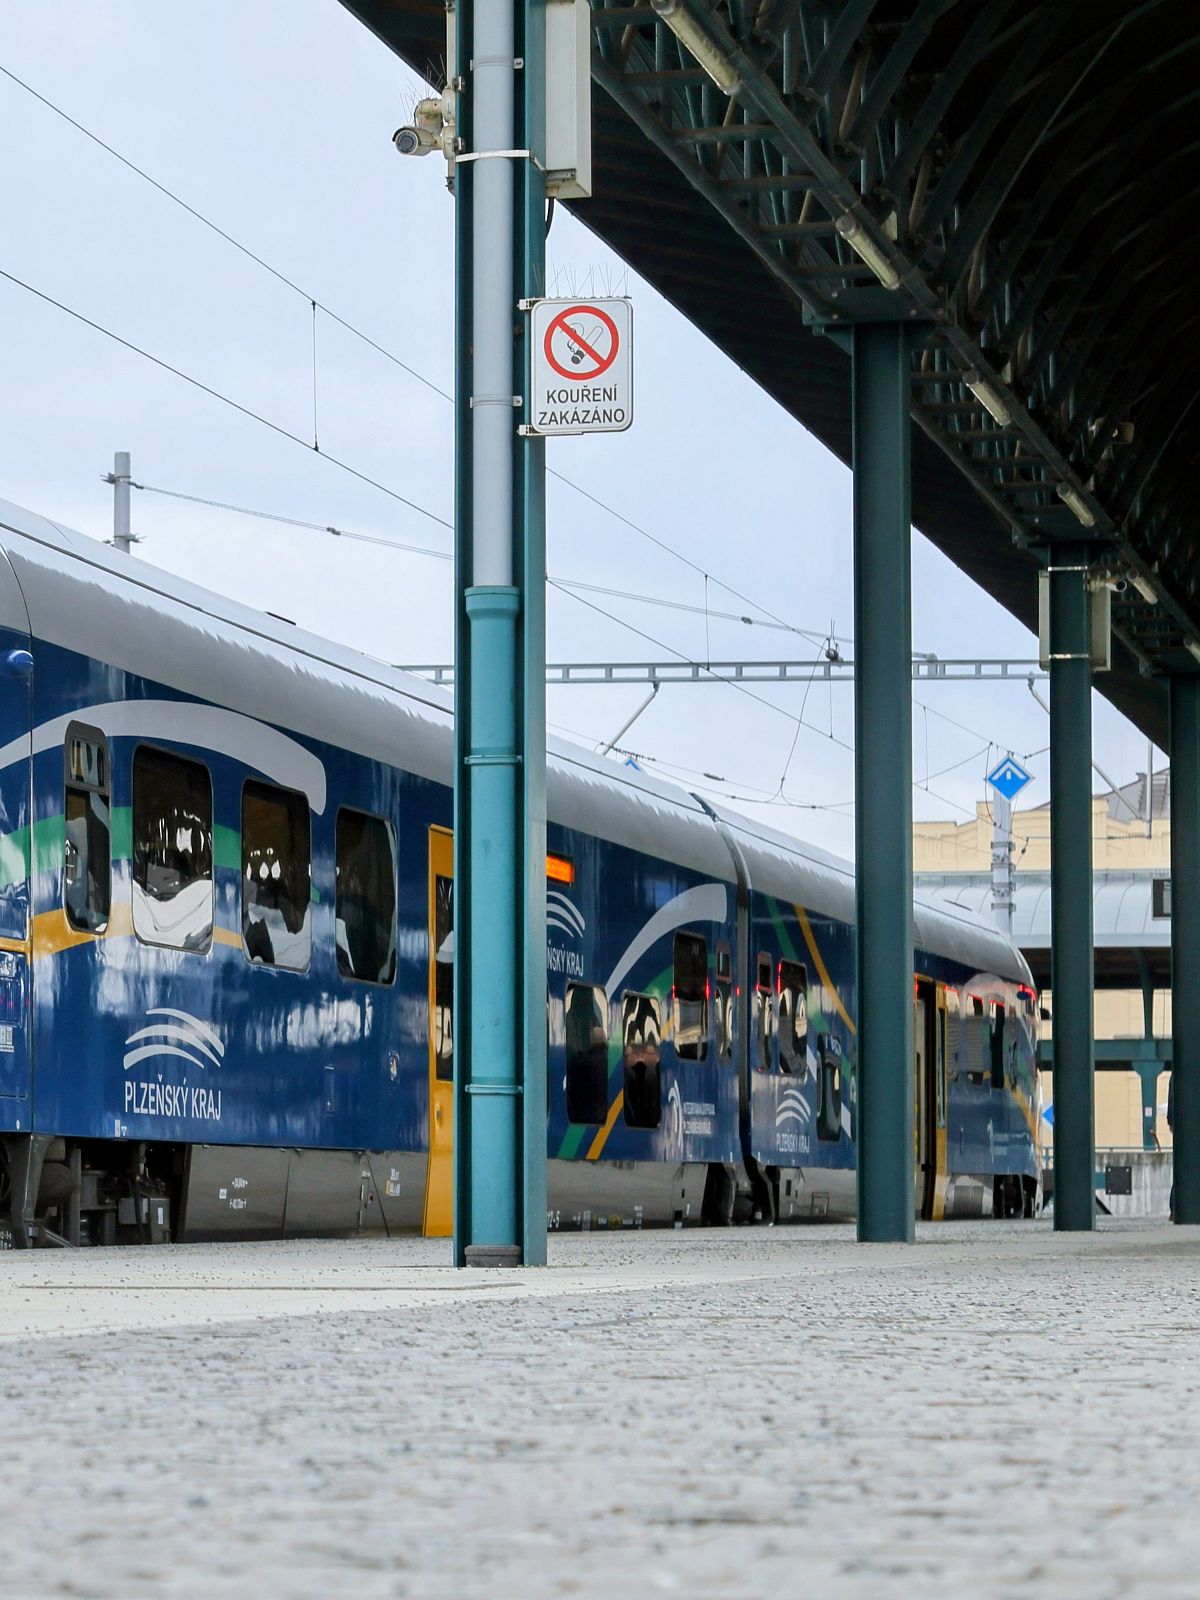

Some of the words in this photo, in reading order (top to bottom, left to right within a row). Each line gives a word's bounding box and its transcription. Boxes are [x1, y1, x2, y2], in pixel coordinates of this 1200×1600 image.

[546, 384, 618, 405] KOUŘENÍ
[538, 406, 625, 426] ZAKÁZÁNO
[547, 939, 566, 973] ŇSKÝ
[567, 951, 584, 977] KRAJ
[125, 1073, 189, 1118] PLZEŇSKÝ
[191, 1087, 221, 1121] KRAJ
